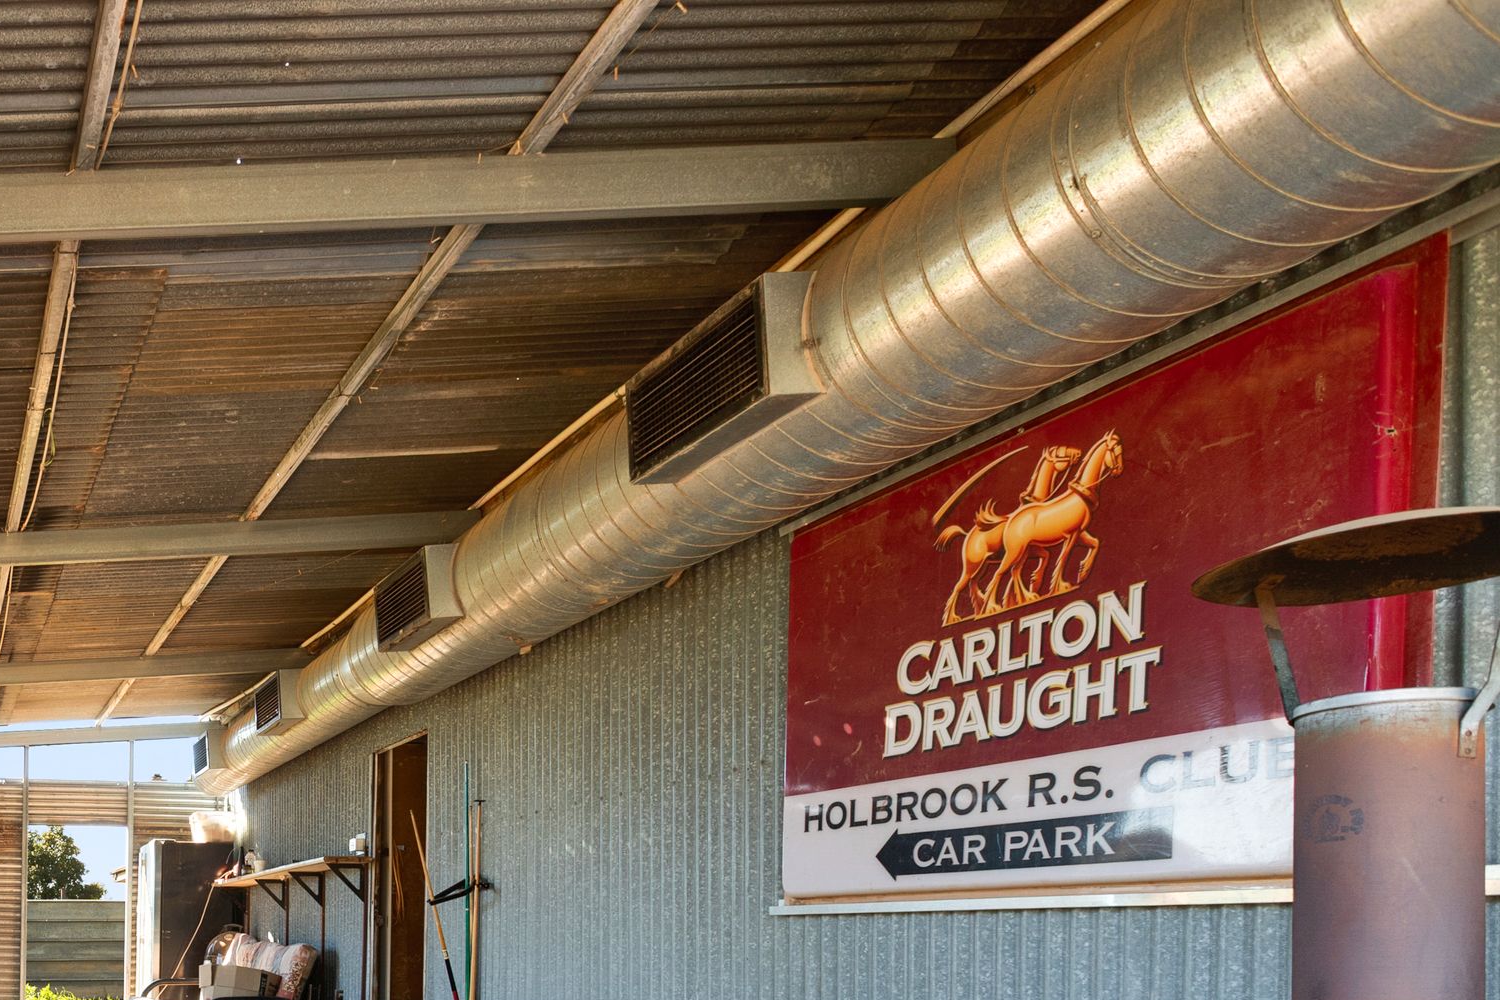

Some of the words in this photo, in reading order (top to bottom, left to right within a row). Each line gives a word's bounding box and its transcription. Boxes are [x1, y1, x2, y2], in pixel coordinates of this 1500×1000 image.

[897, 580, 1147, 696] CARLTON
[882, 645, 1163, 760] DRAUGHT
[804, 778, 1008, 833] HOLBROOK
[1027, 765, 1114, 808] R.S.
[913, 834, 987, 868] CAR
[1003, 821, 1116, 862] PARK
